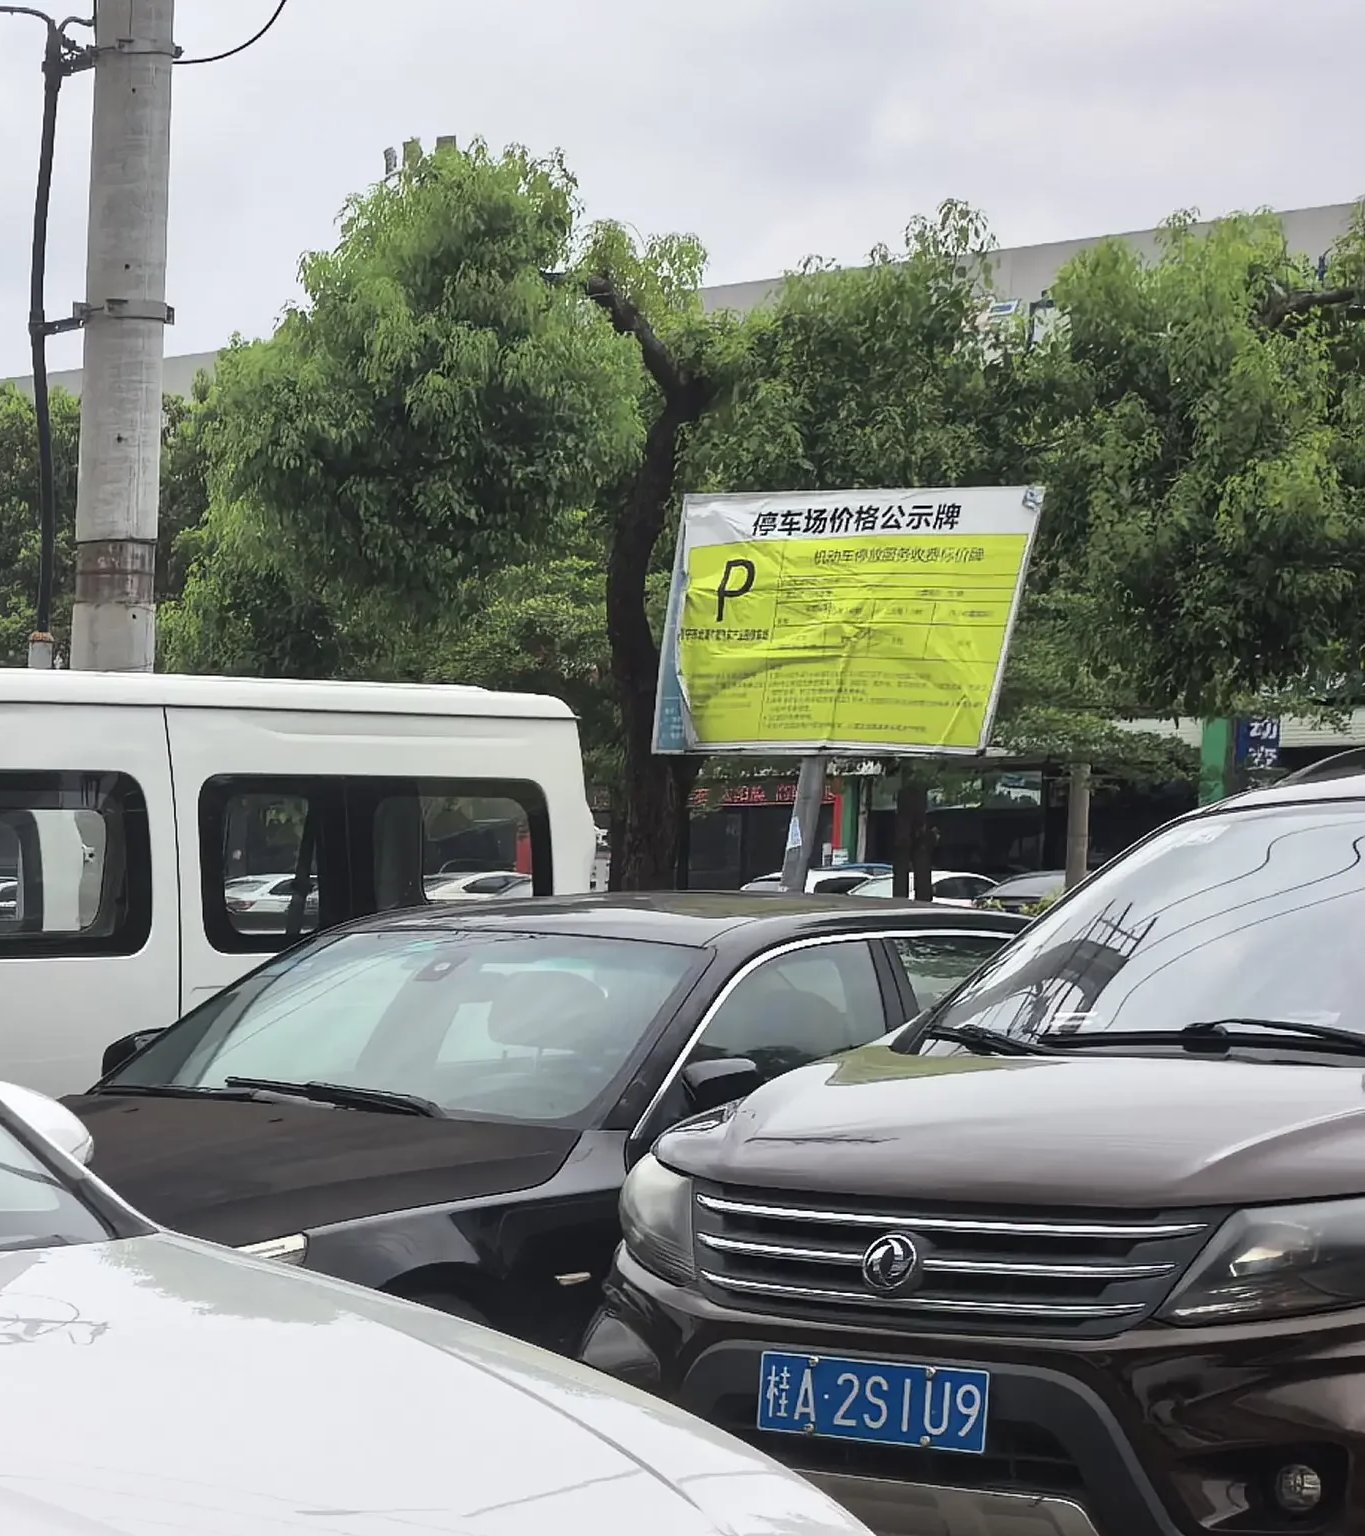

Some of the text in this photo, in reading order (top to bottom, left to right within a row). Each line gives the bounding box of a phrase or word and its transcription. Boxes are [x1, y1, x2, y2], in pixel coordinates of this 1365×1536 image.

[752, 503, 961, 536] 停车场价格公示牌
[716, 559, 756, 622] P
